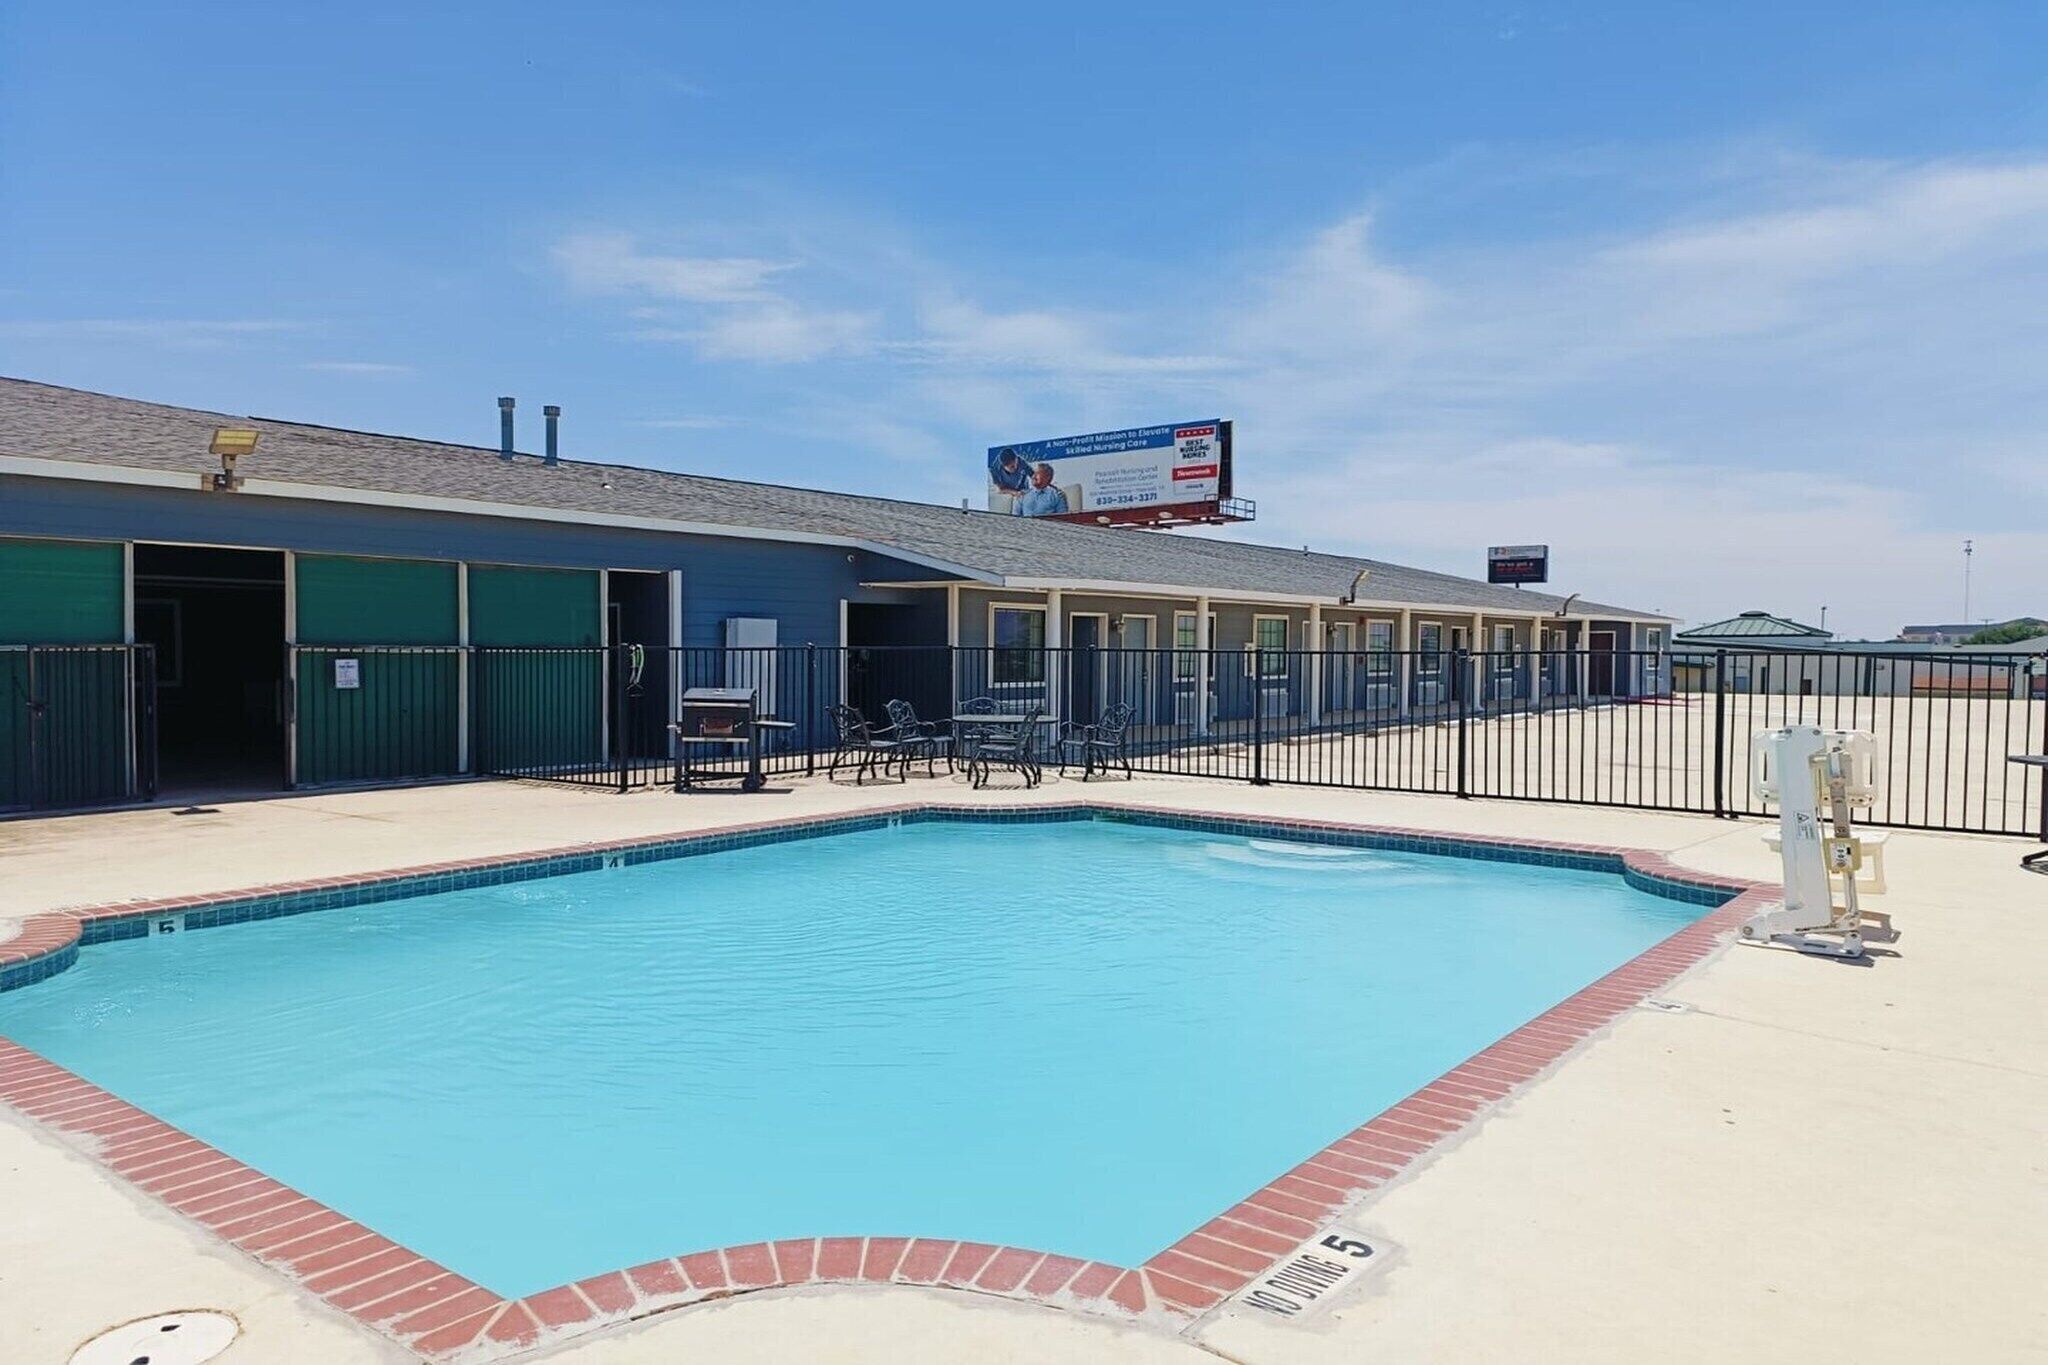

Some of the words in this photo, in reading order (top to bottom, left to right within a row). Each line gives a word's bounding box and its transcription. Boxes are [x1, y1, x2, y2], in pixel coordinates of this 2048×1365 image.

[1052, 434, 1095, 448] Non-Profit
[1095, 430, 1127, 442] Mission
[1128, 430, 1137, 438] to
[1138, 427, 1170, 437] Elevate
[1065, 445, 1092, 455] Skilled
[1093, 441, 1126, 452] Nursing
[1127, 439, 1148, 448] Care
[1180, 444, 1210, 453] NURSING
[1182, 451, 1206, 459] HOMES
[158, 919, 176, 934] 5
[1319, 1234, 1374, 1258] 5
[1266, 1254, 1350, 1300] DIVING
[1242, 1290, 1303, 1319] NO
